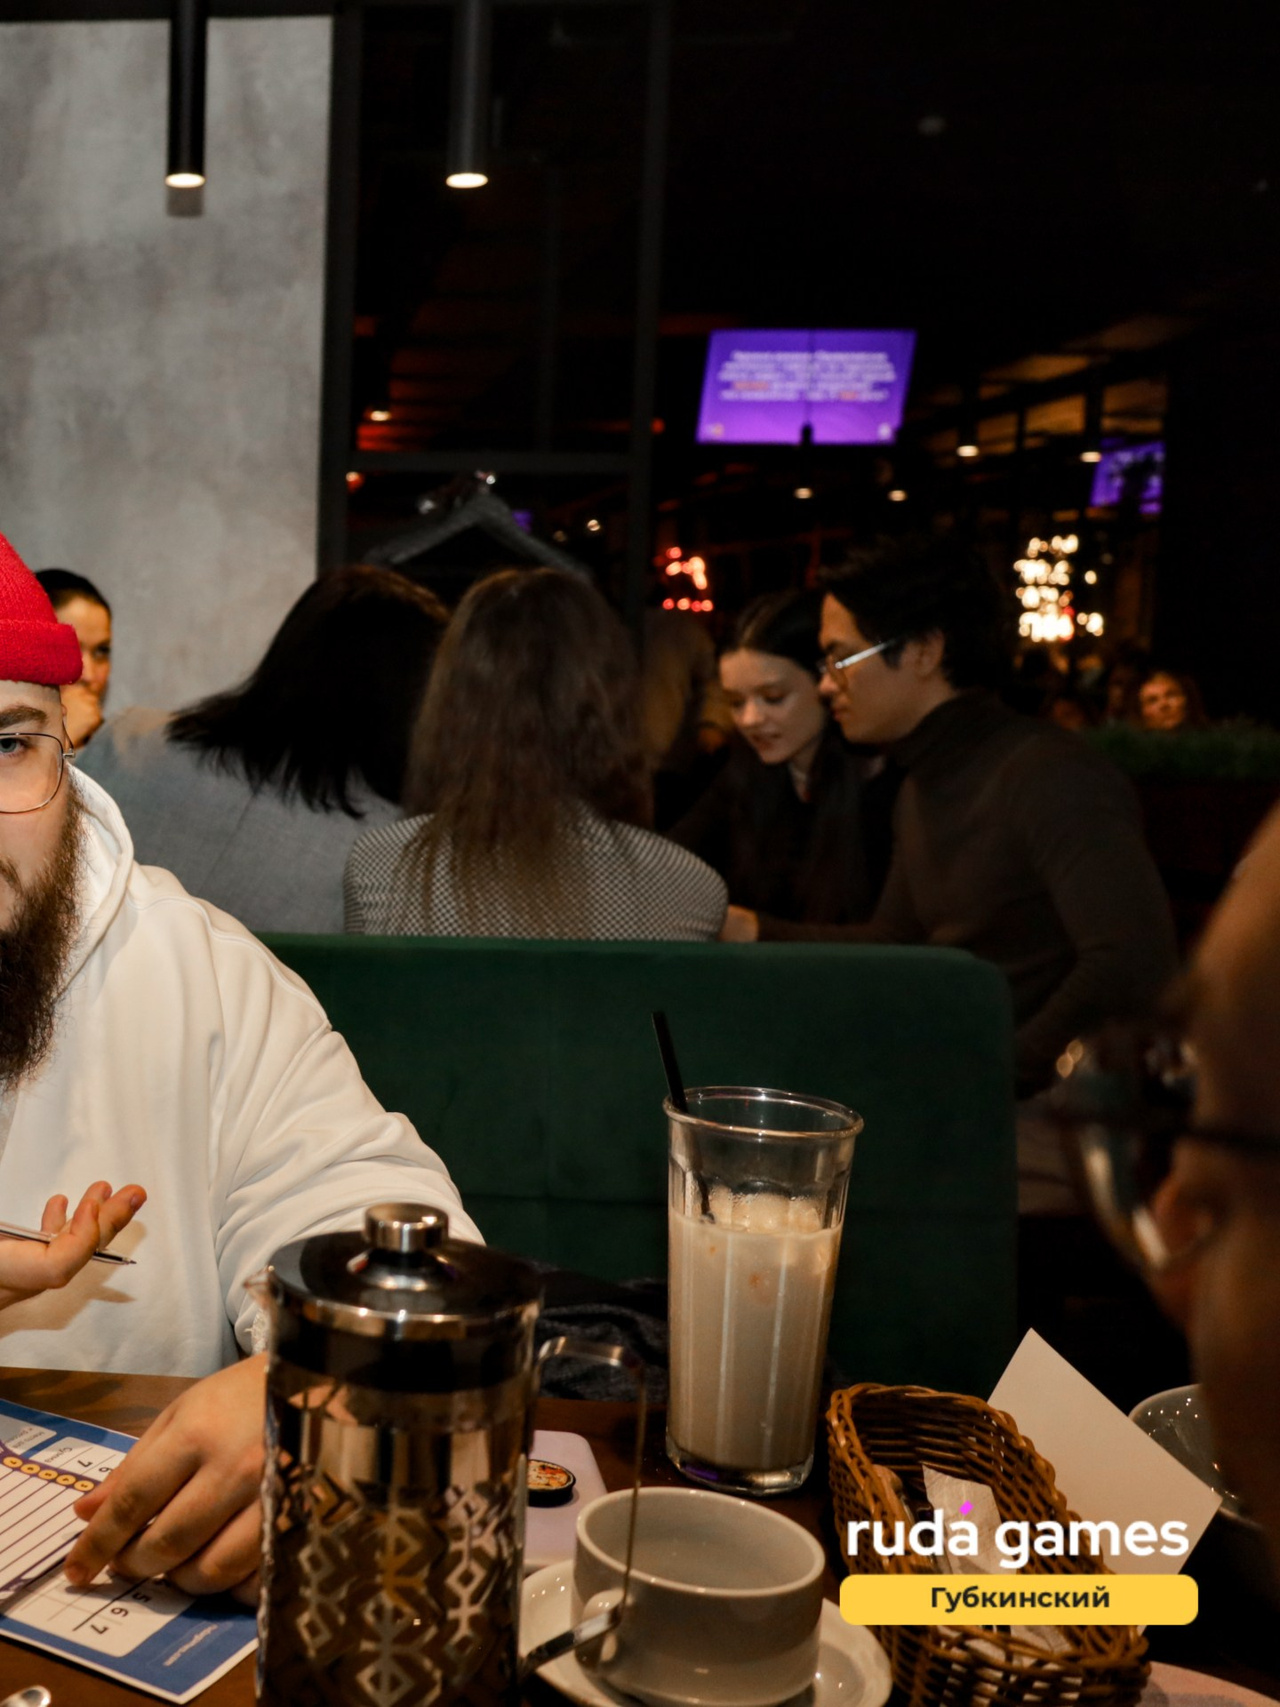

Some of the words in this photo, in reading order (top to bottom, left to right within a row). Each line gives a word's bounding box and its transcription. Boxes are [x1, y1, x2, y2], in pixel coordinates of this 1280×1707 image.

[77, 1459, 93, 1468] 7
[110, 1607, 129, 1617] 6
[90, 1624, 109, 1634] 7
